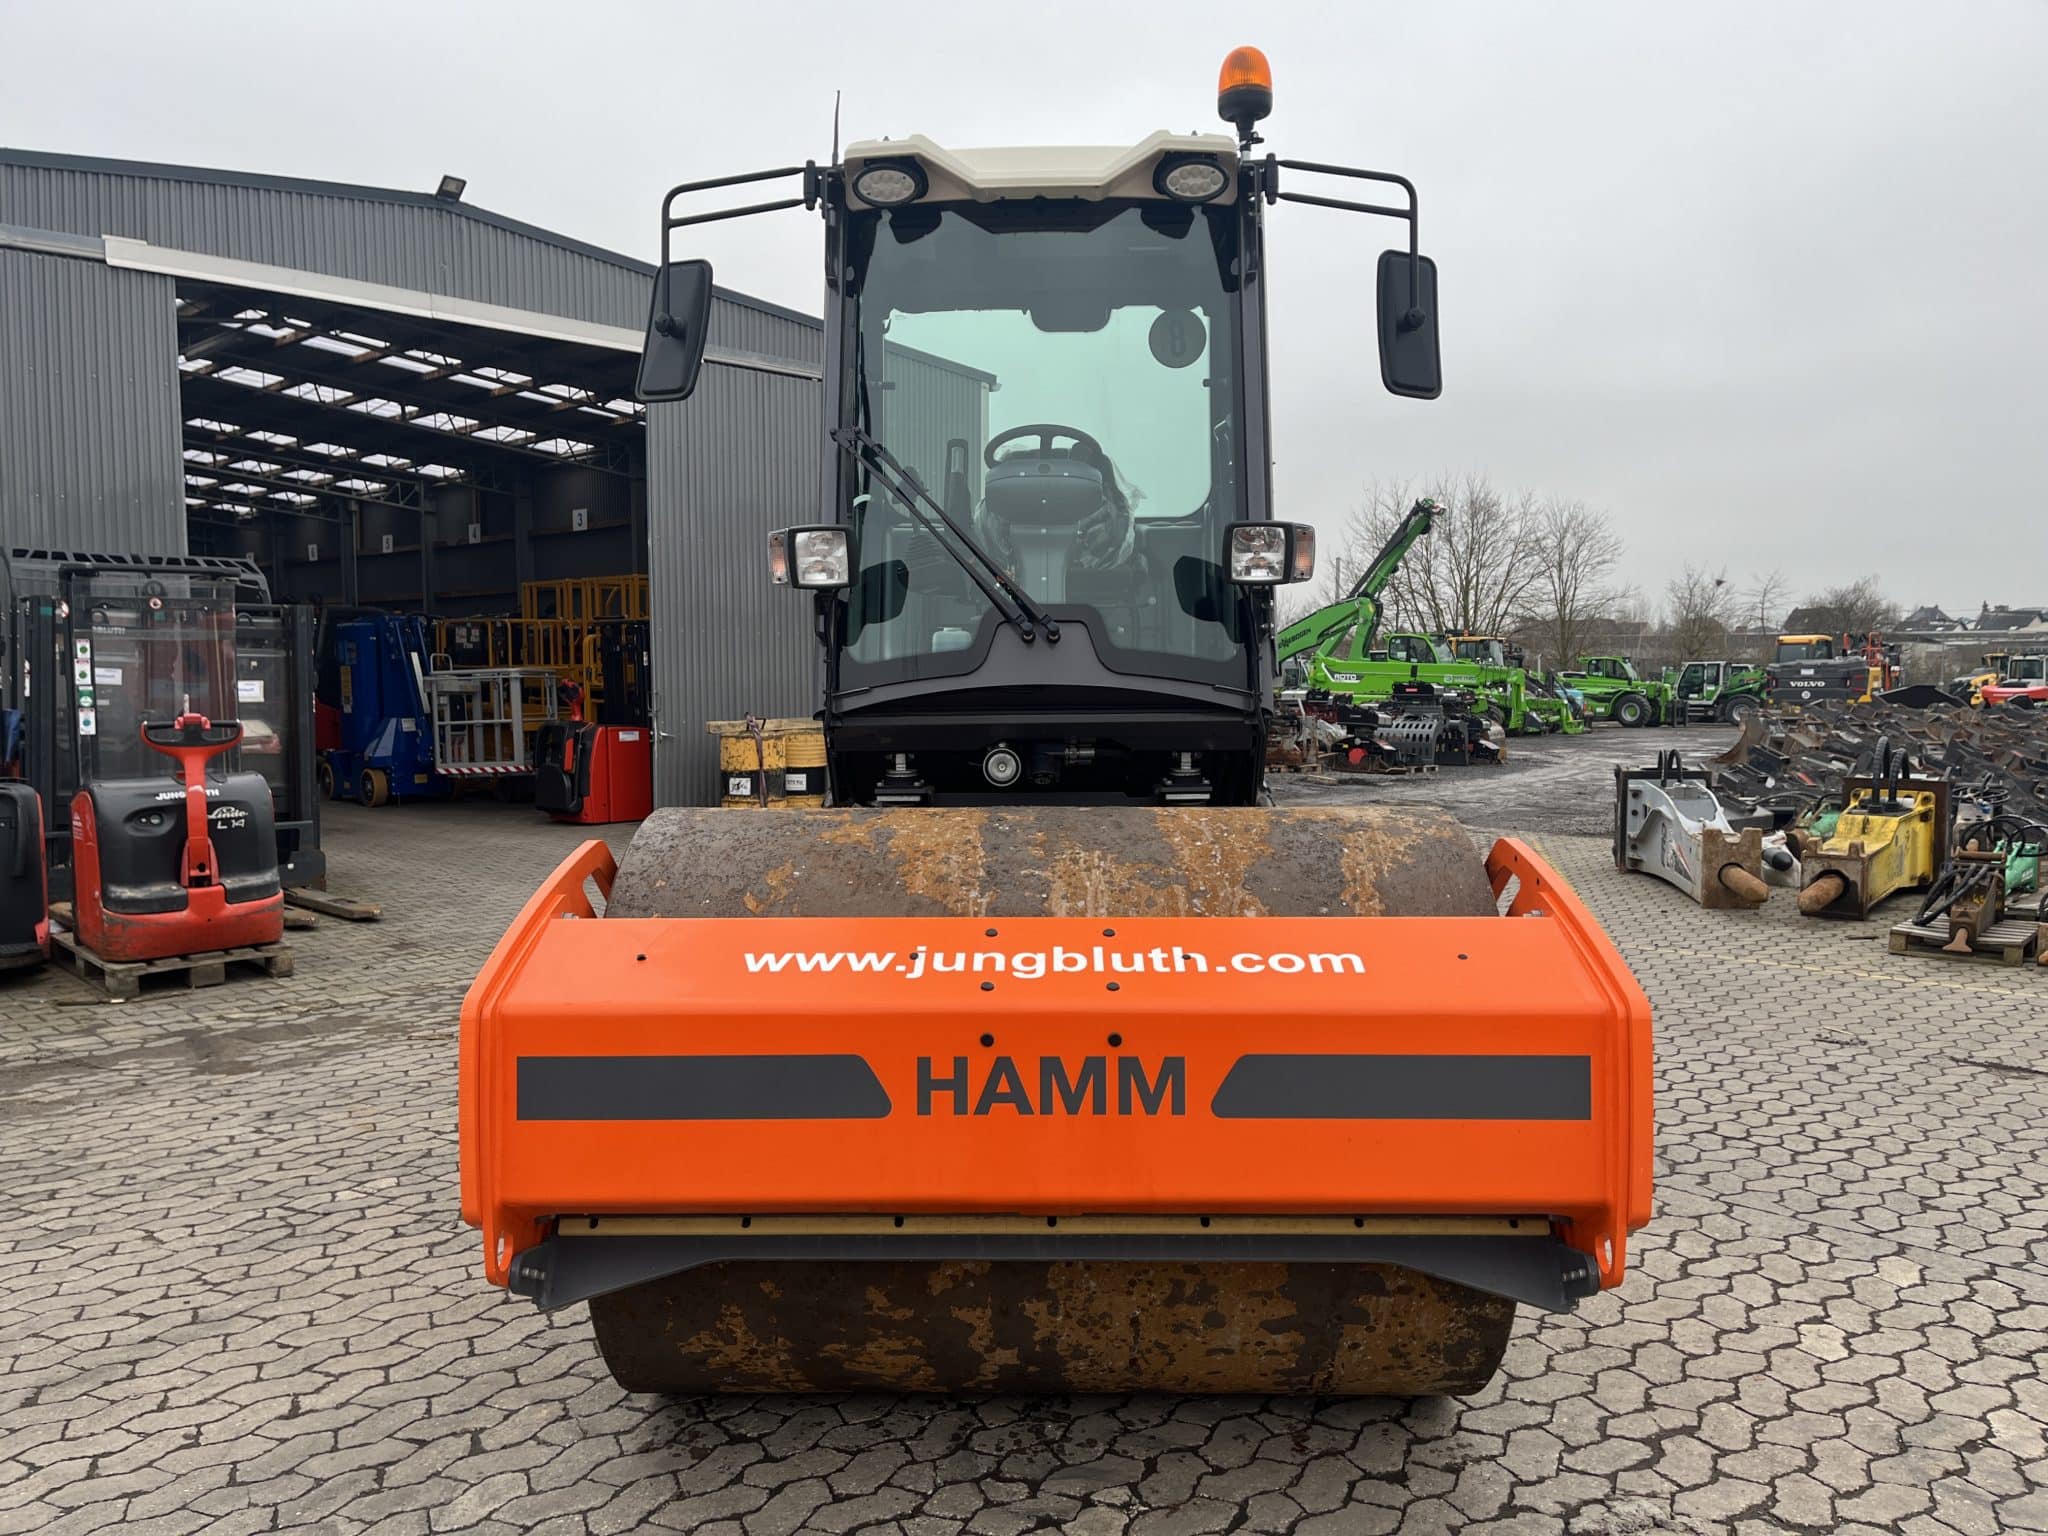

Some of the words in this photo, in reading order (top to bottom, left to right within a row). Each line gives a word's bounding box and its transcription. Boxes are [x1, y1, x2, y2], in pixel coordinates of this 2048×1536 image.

[576, 512, 584, 528] 3
[471, 526, 478, 541] 4
[155, 784, 220, 801] JUNGTH
[207, 806, 248, 820] Linde
[217, 820, 228, 829] L
[231, 818, 245, 828] 14
[744, 945, 1365, 979] www.jungbluth.com
[916, 1055, 1186, 1116] HAMM
